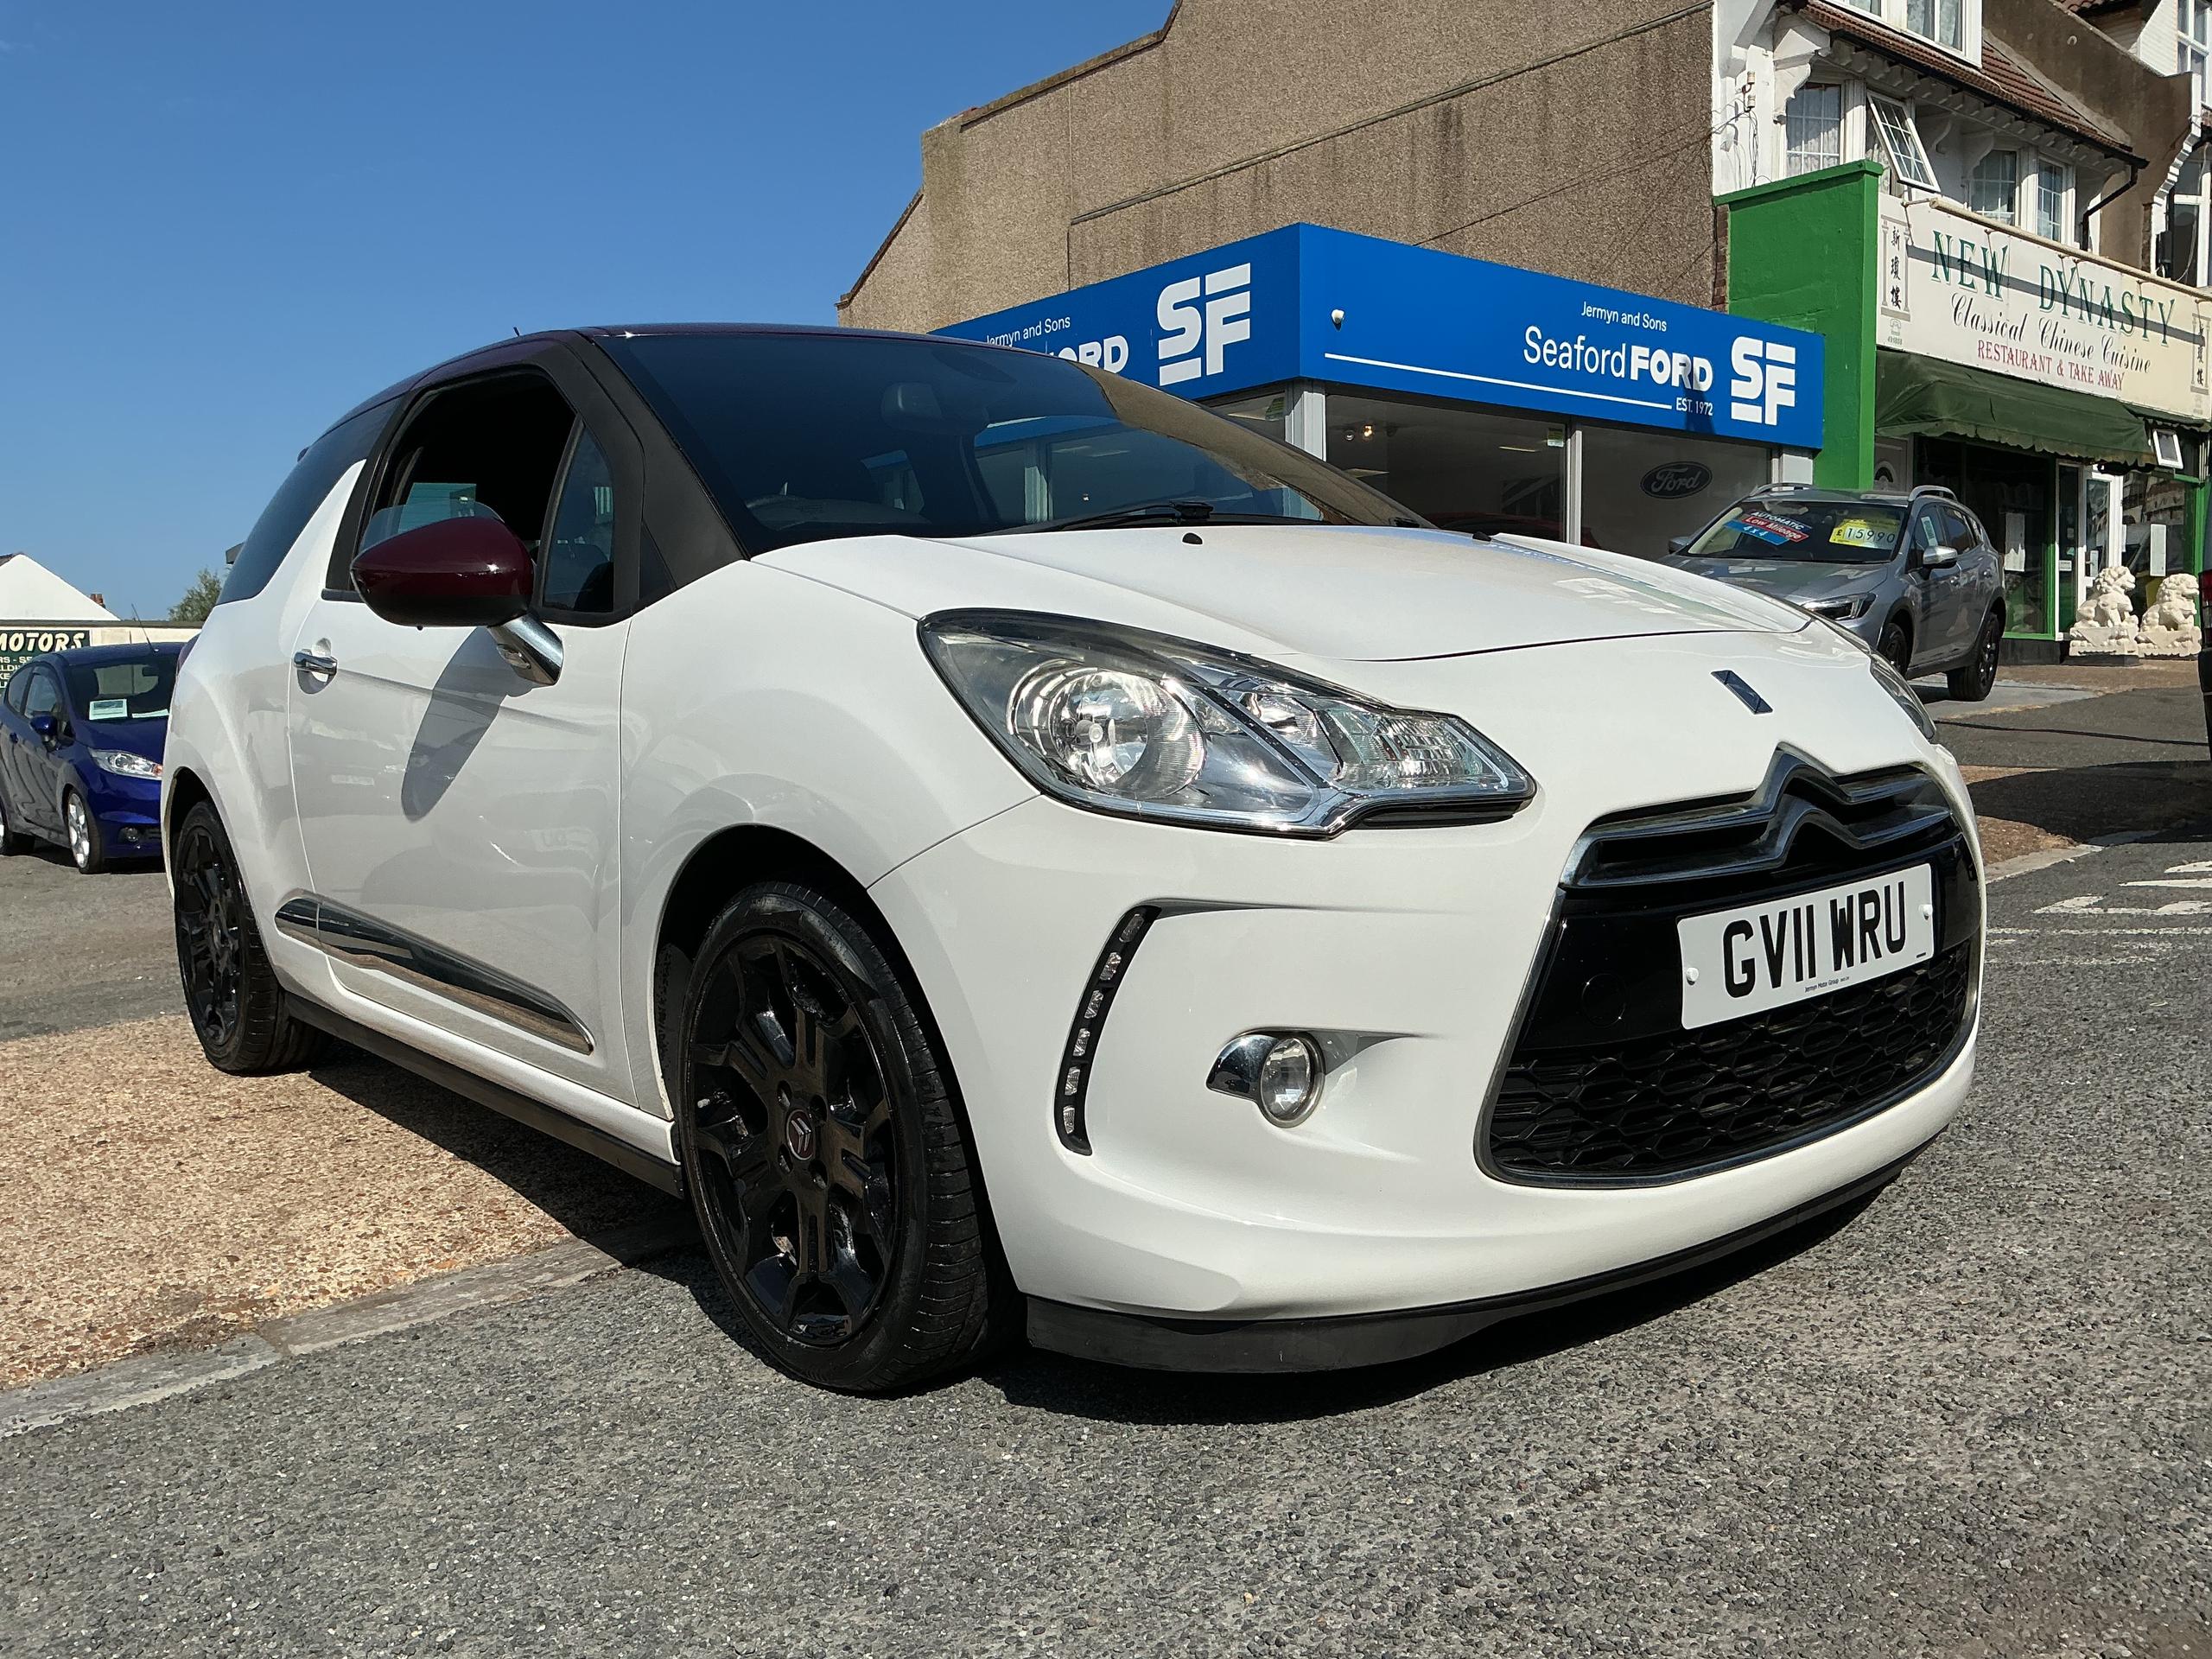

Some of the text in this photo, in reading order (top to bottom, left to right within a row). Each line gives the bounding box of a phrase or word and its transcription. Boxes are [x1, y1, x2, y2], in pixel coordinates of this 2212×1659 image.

[1931, 230, 2176, 346] NEW DYNASTY
[1023, 321, 1042, 340] and
[1044, 316, 1071, 334] Sons
[1580, 301, 1668, 333] Jermyn and Sons
[1951, 292, 2151, 373] Classical Chinese Cuisine
[1978, 340, 2126, 391] RESTAURANT & TAKE AWAY
[1694, 400, 1713, 416] 1972
[1651, 467, 1701, 493] Ford
[1746, 516, 1802, 539] Low Mileage
[1751, 512, 1805, 531] AUTOMATIC
[1723, 880, 1906, 999] GV11 WRU
